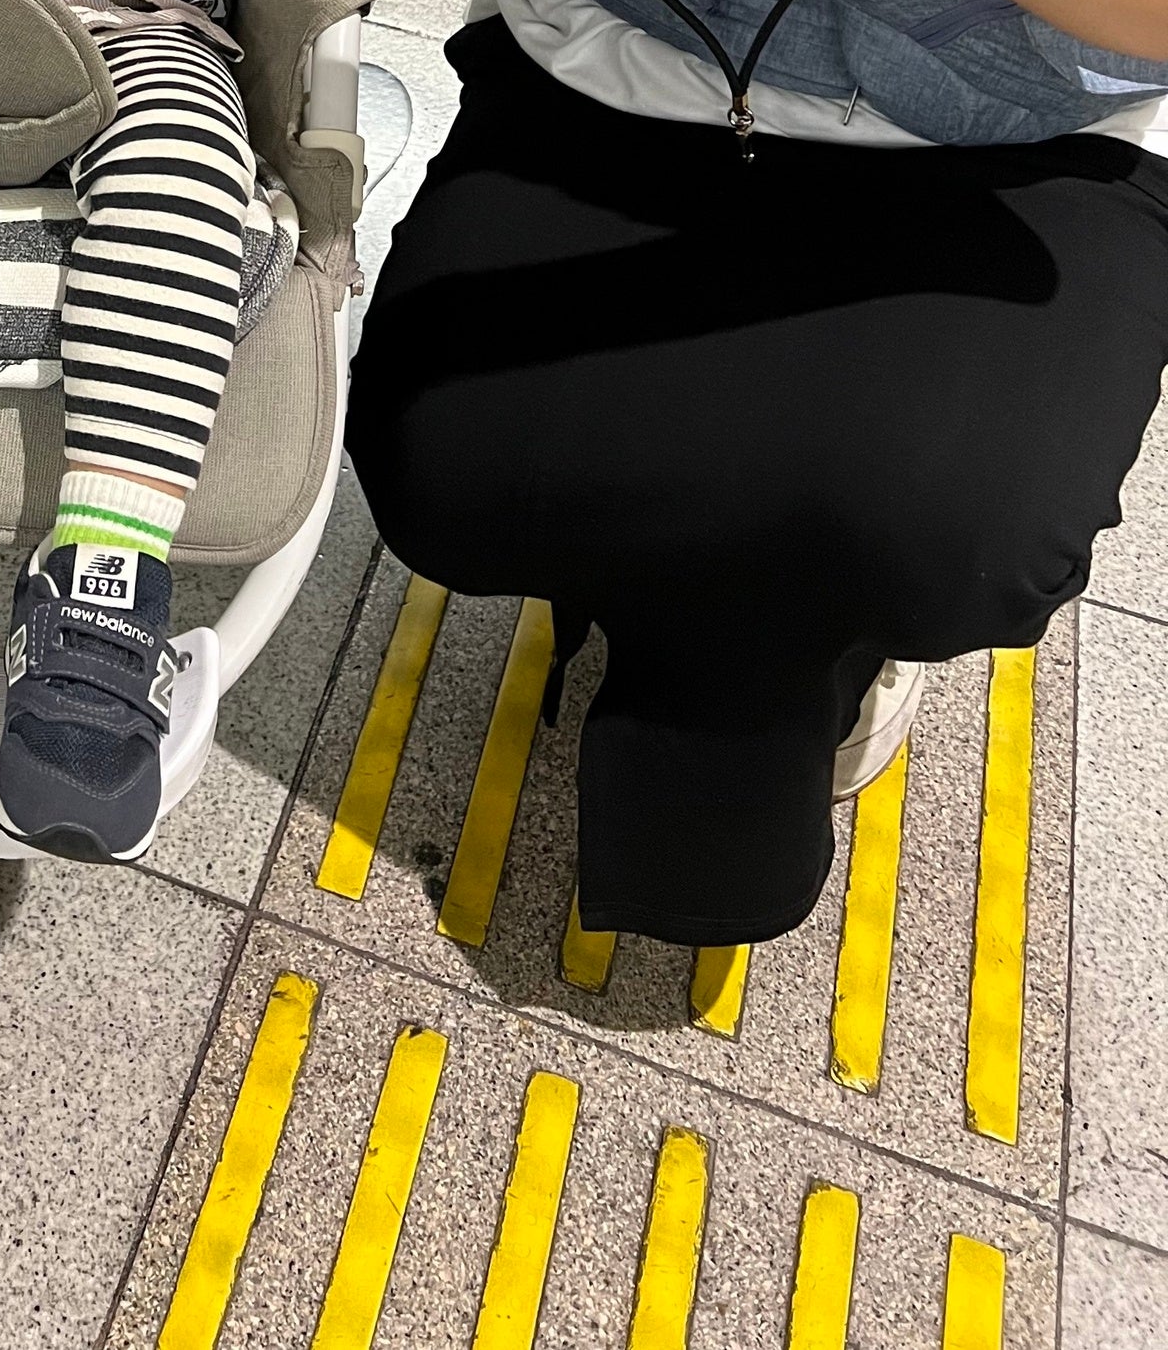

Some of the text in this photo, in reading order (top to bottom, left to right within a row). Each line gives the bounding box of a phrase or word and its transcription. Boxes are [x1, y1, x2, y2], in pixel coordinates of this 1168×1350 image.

[85, 577, 122, 597] 996
[60, 605, 155, 648] new balance
